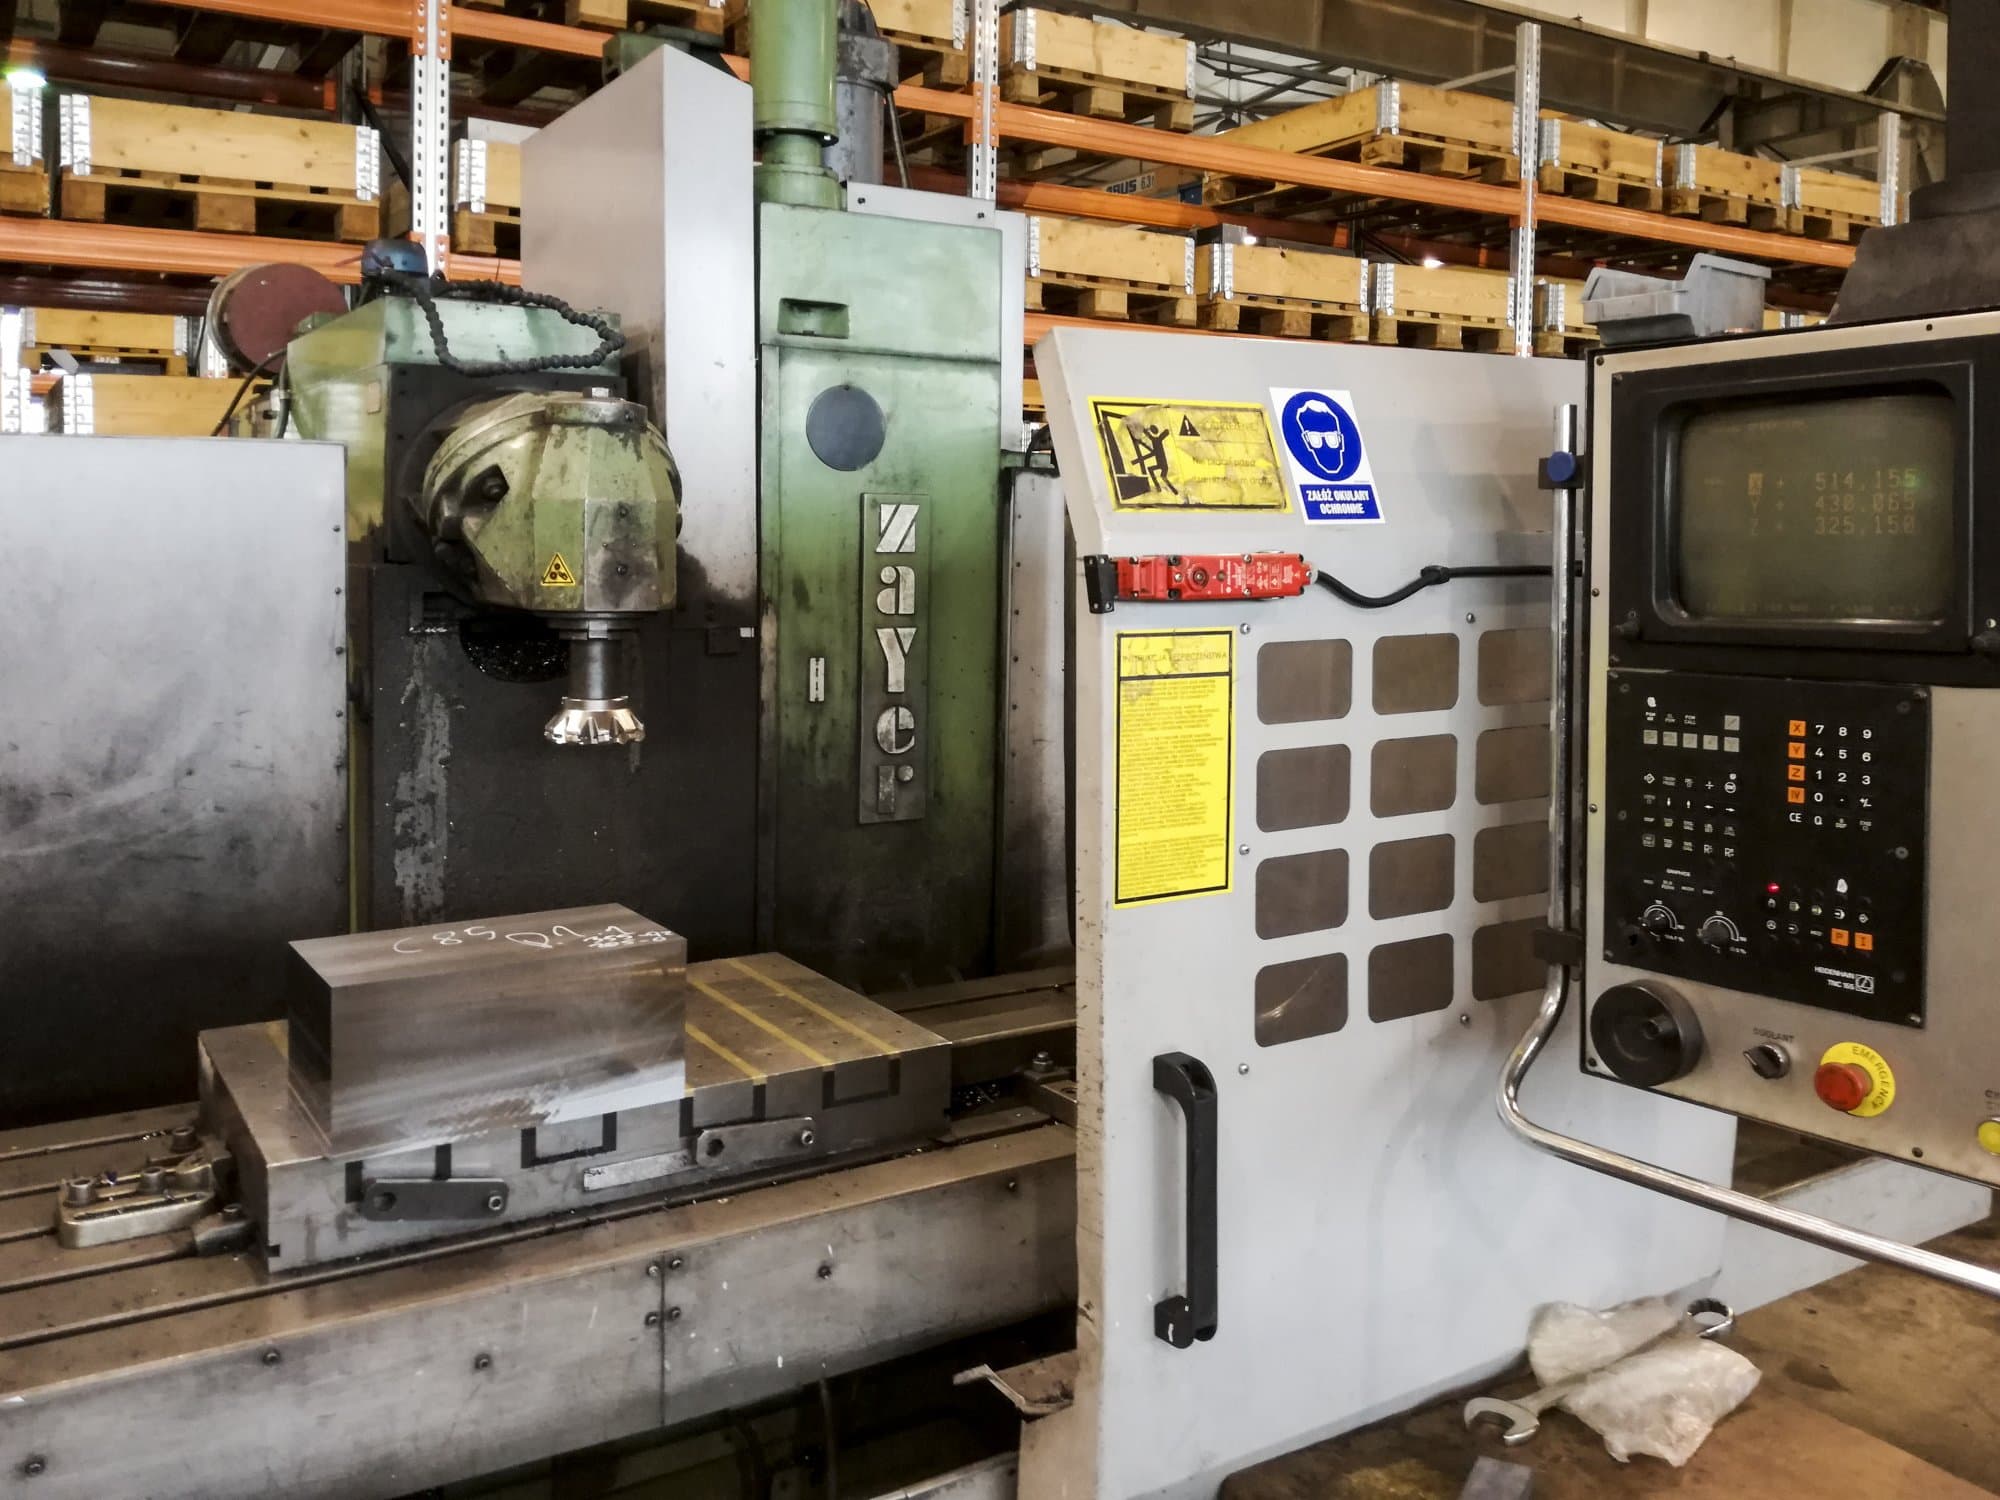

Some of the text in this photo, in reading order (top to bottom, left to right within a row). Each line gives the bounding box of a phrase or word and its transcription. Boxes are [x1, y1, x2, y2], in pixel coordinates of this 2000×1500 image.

[1334, 490, 1370, 501] OKULARY
[1320, 503, 1365, 515] OCHRONNE
[1815, 724, 1824, 735] 7
[1838, 726, 1848, 737] 8
[1862, 729, 1872, 739] 9
[1815, 747, 1824, 758] 4
[1838, 749, 1848, 759] 5
[1862, 751, 1872, 762] 6
[1815, 770, 1822, 780] 1
[1838, 772, 1847, 783] 2
[1862, 775, 1871, 785] 3
[1814, 792, 1823, 803] 0
[1789, 812, 1803, 823] CE
[1814, 815, 1823, 825] Q
[1852, 1045, 1890, 1109] EMERGENCY
